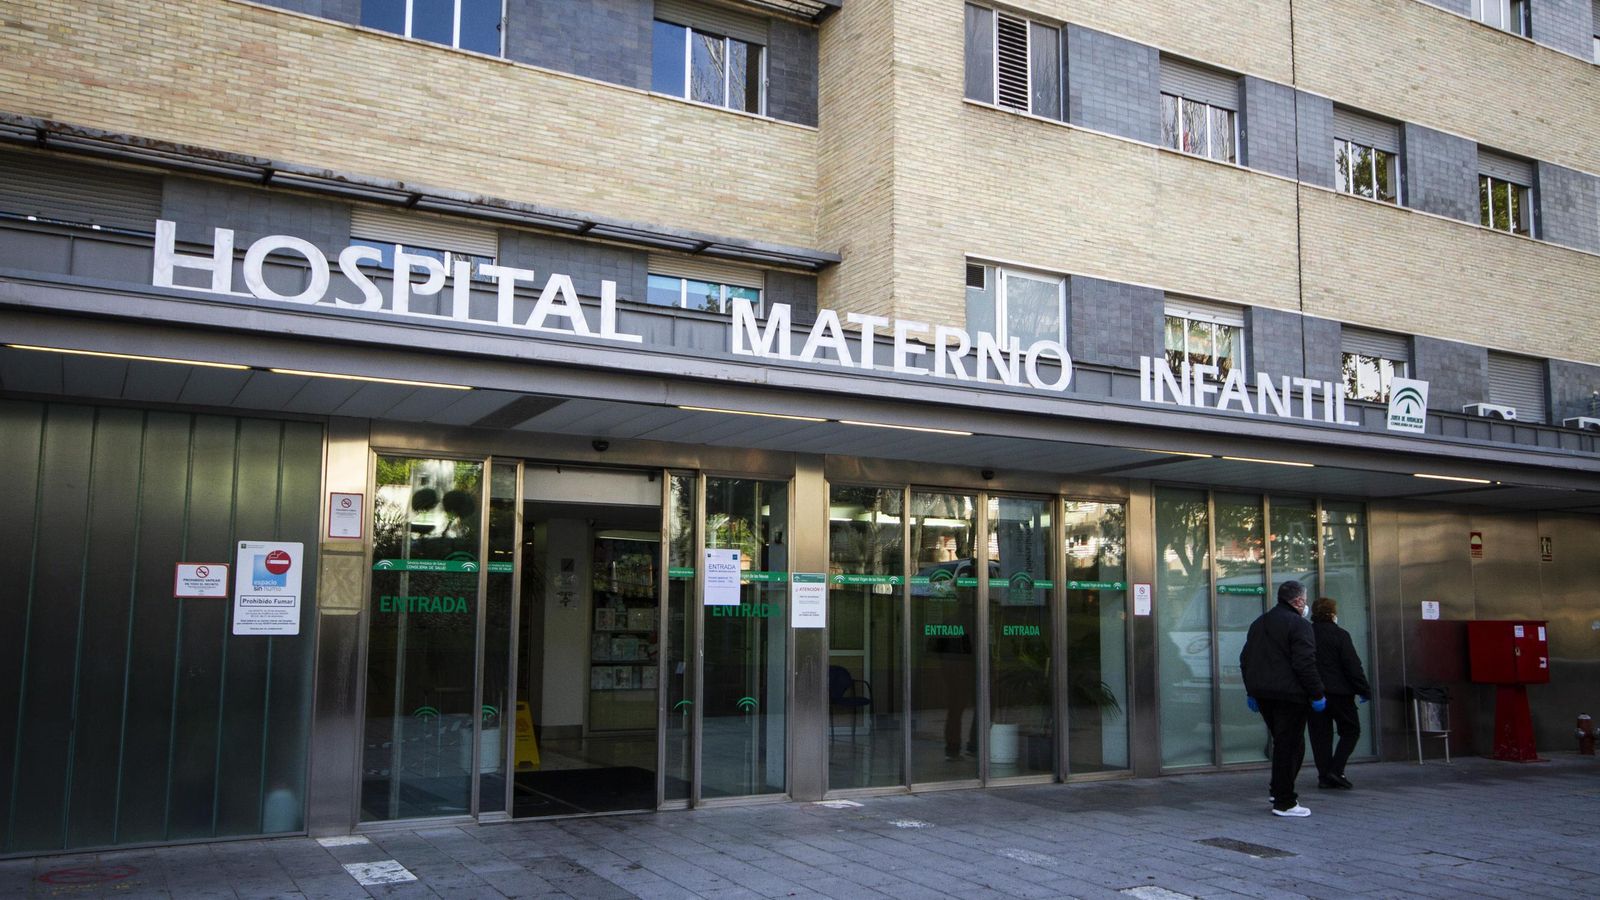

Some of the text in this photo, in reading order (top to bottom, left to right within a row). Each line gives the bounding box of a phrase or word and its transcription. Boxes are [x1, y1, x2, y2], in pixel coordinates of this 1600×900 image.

[152, 219, 1360, 426] HOSPITAL MATERNO INFANTIL
[380, 596, 468, 613] ENTRADA
[925, 624, 965, 636] ENTRADA
[1003, 625, 1040, 636] ENTRADA
